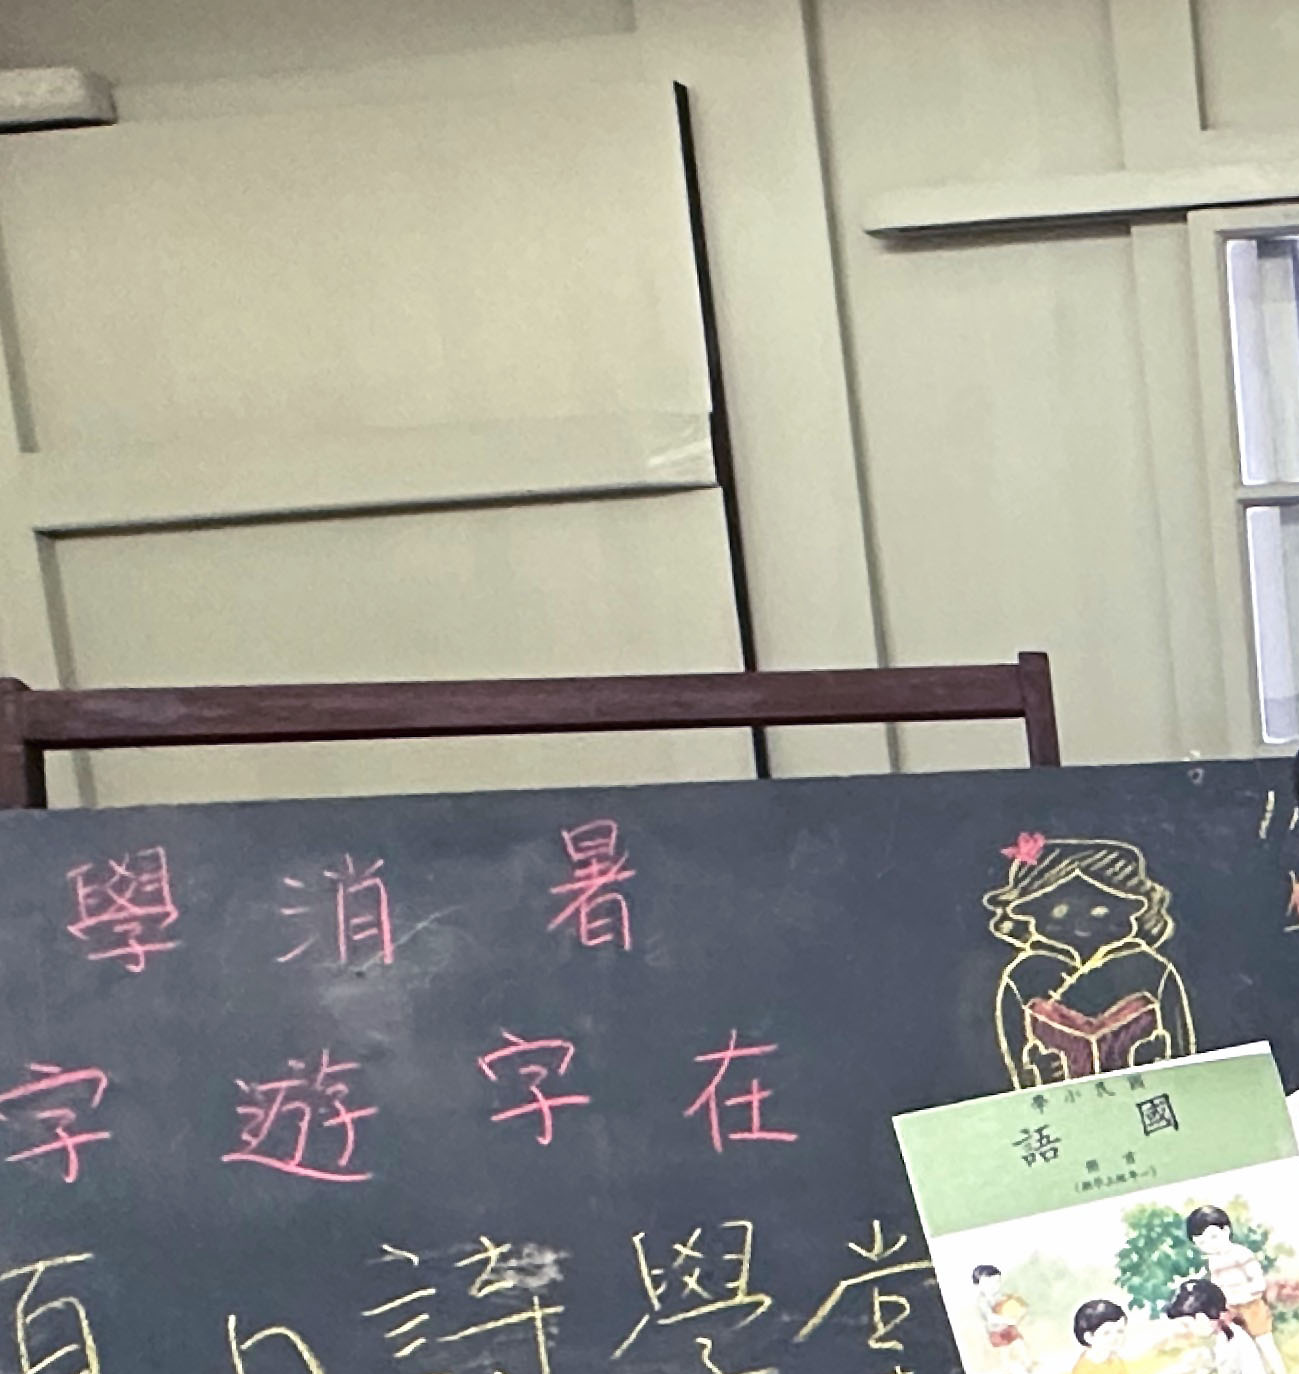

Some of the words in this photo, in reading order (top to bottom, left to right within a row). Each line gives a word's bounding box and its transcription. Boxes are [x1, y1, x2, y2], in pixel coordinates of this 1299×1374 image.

[66, 818, 637, 973] 學消暑
[0, 1029, 799, 1182] 字遊字在
